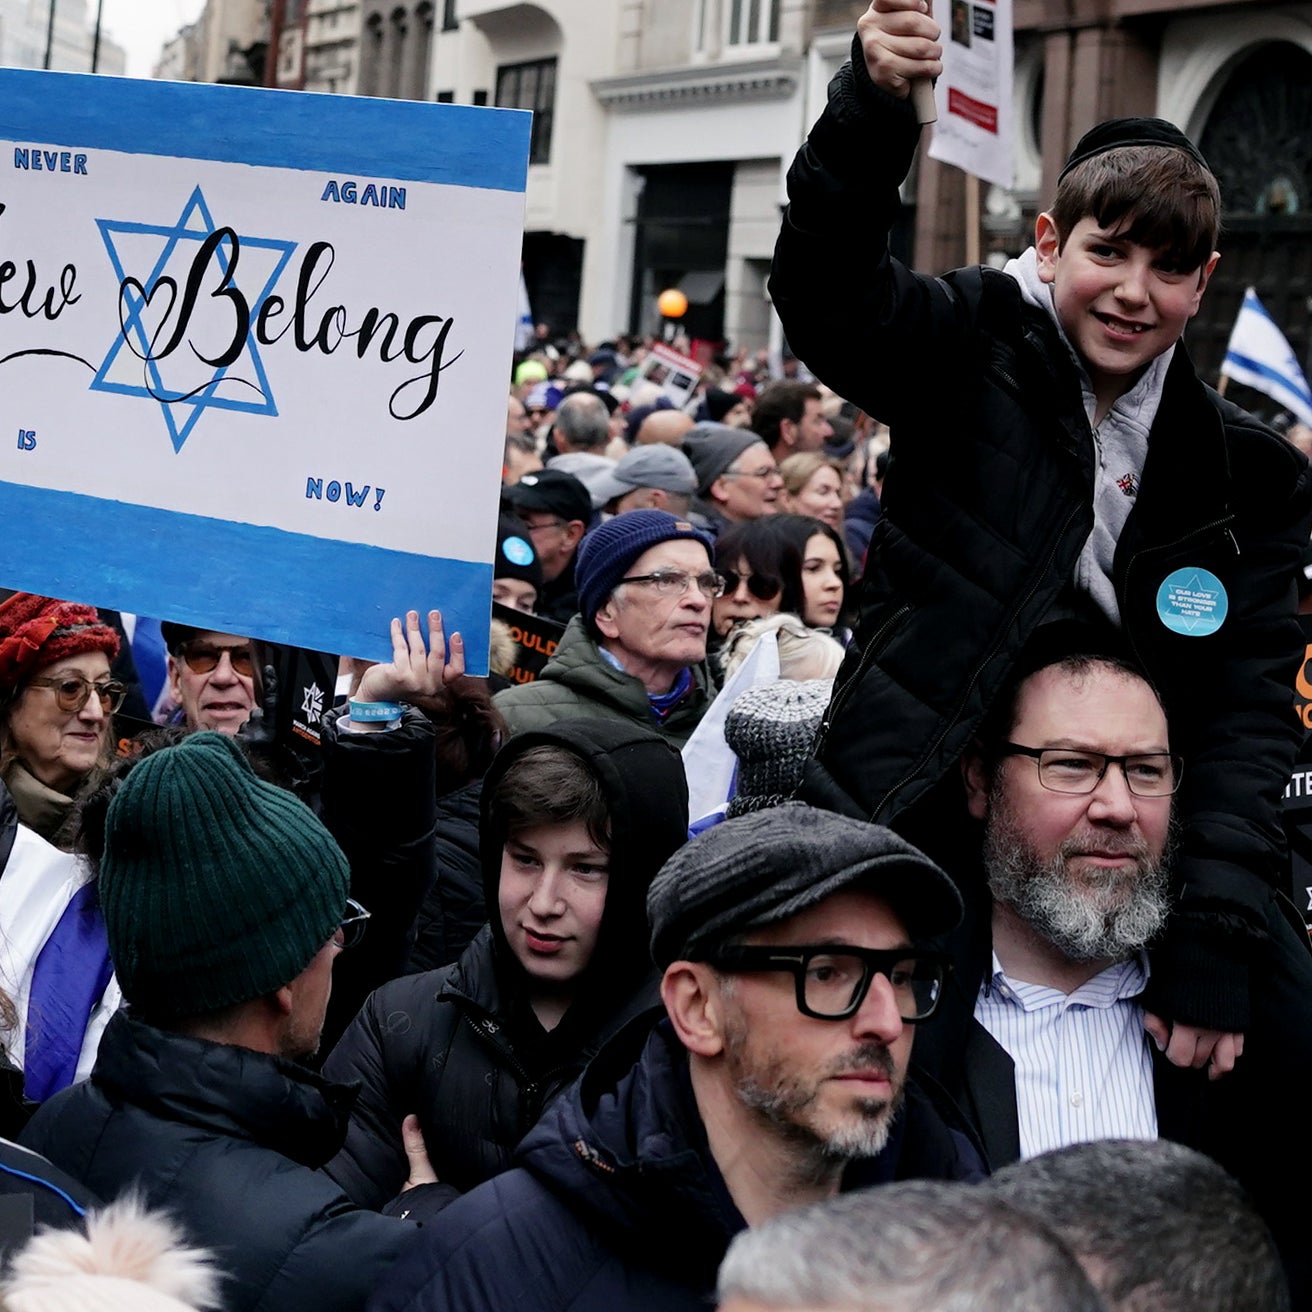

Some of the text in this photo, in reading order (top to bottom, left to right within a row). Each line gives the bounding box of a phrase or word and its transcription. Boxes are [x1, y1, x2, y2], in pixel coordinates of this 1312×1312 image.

[14, 148, 407, 210] NEVER AGAIN
[119, 226, 465, 420] Belong
[17, 429, 386, 512] IS NOW!
